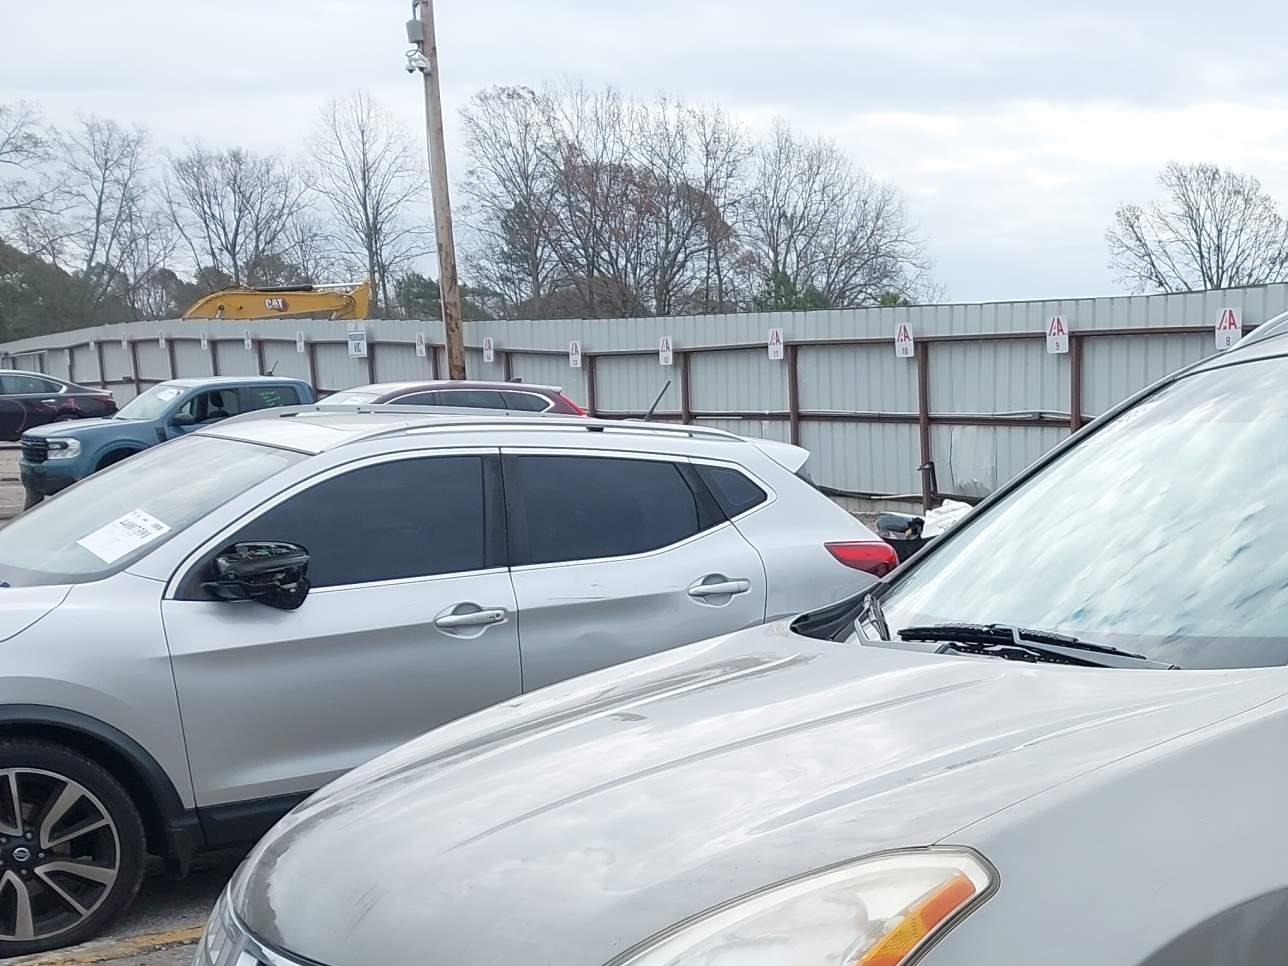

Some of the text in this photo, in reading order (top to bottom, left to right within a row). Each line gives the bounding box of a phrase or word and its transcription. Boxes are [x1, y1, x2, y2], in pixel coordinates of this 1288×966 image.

[264, 298, 284, 311] CAT
[1225, 336, 1231, 346] 8
[901, 347, 909, 356] 10
